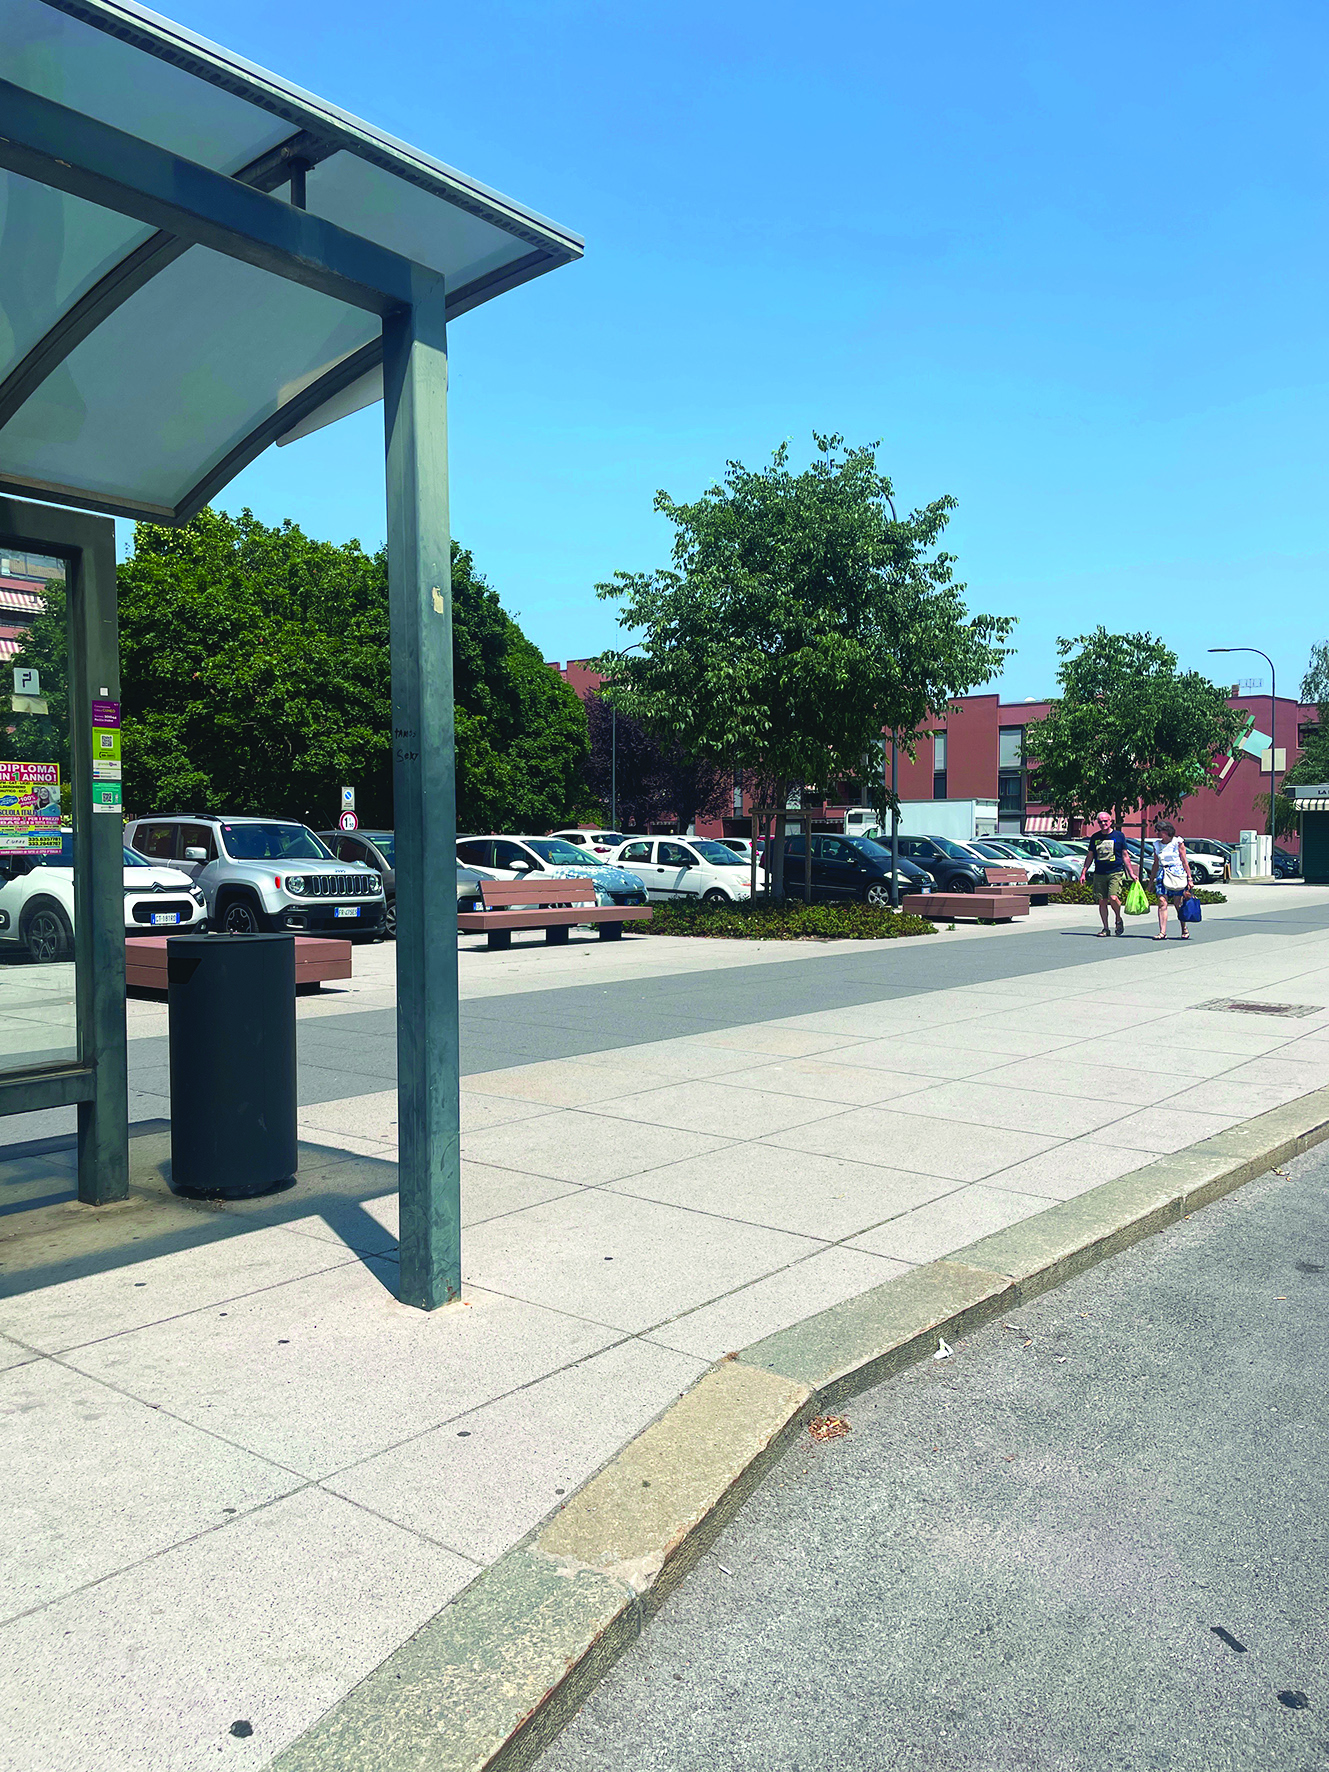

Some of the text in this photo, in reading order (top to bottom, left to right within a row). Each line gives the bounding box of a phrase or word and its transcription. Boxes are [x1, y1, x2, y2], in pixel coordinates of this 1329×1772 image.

[0, 764, 56, 773] DIPLOMA
[12, 772, 19, 780] 1
[22, 774, 57, 782] ANNO!
